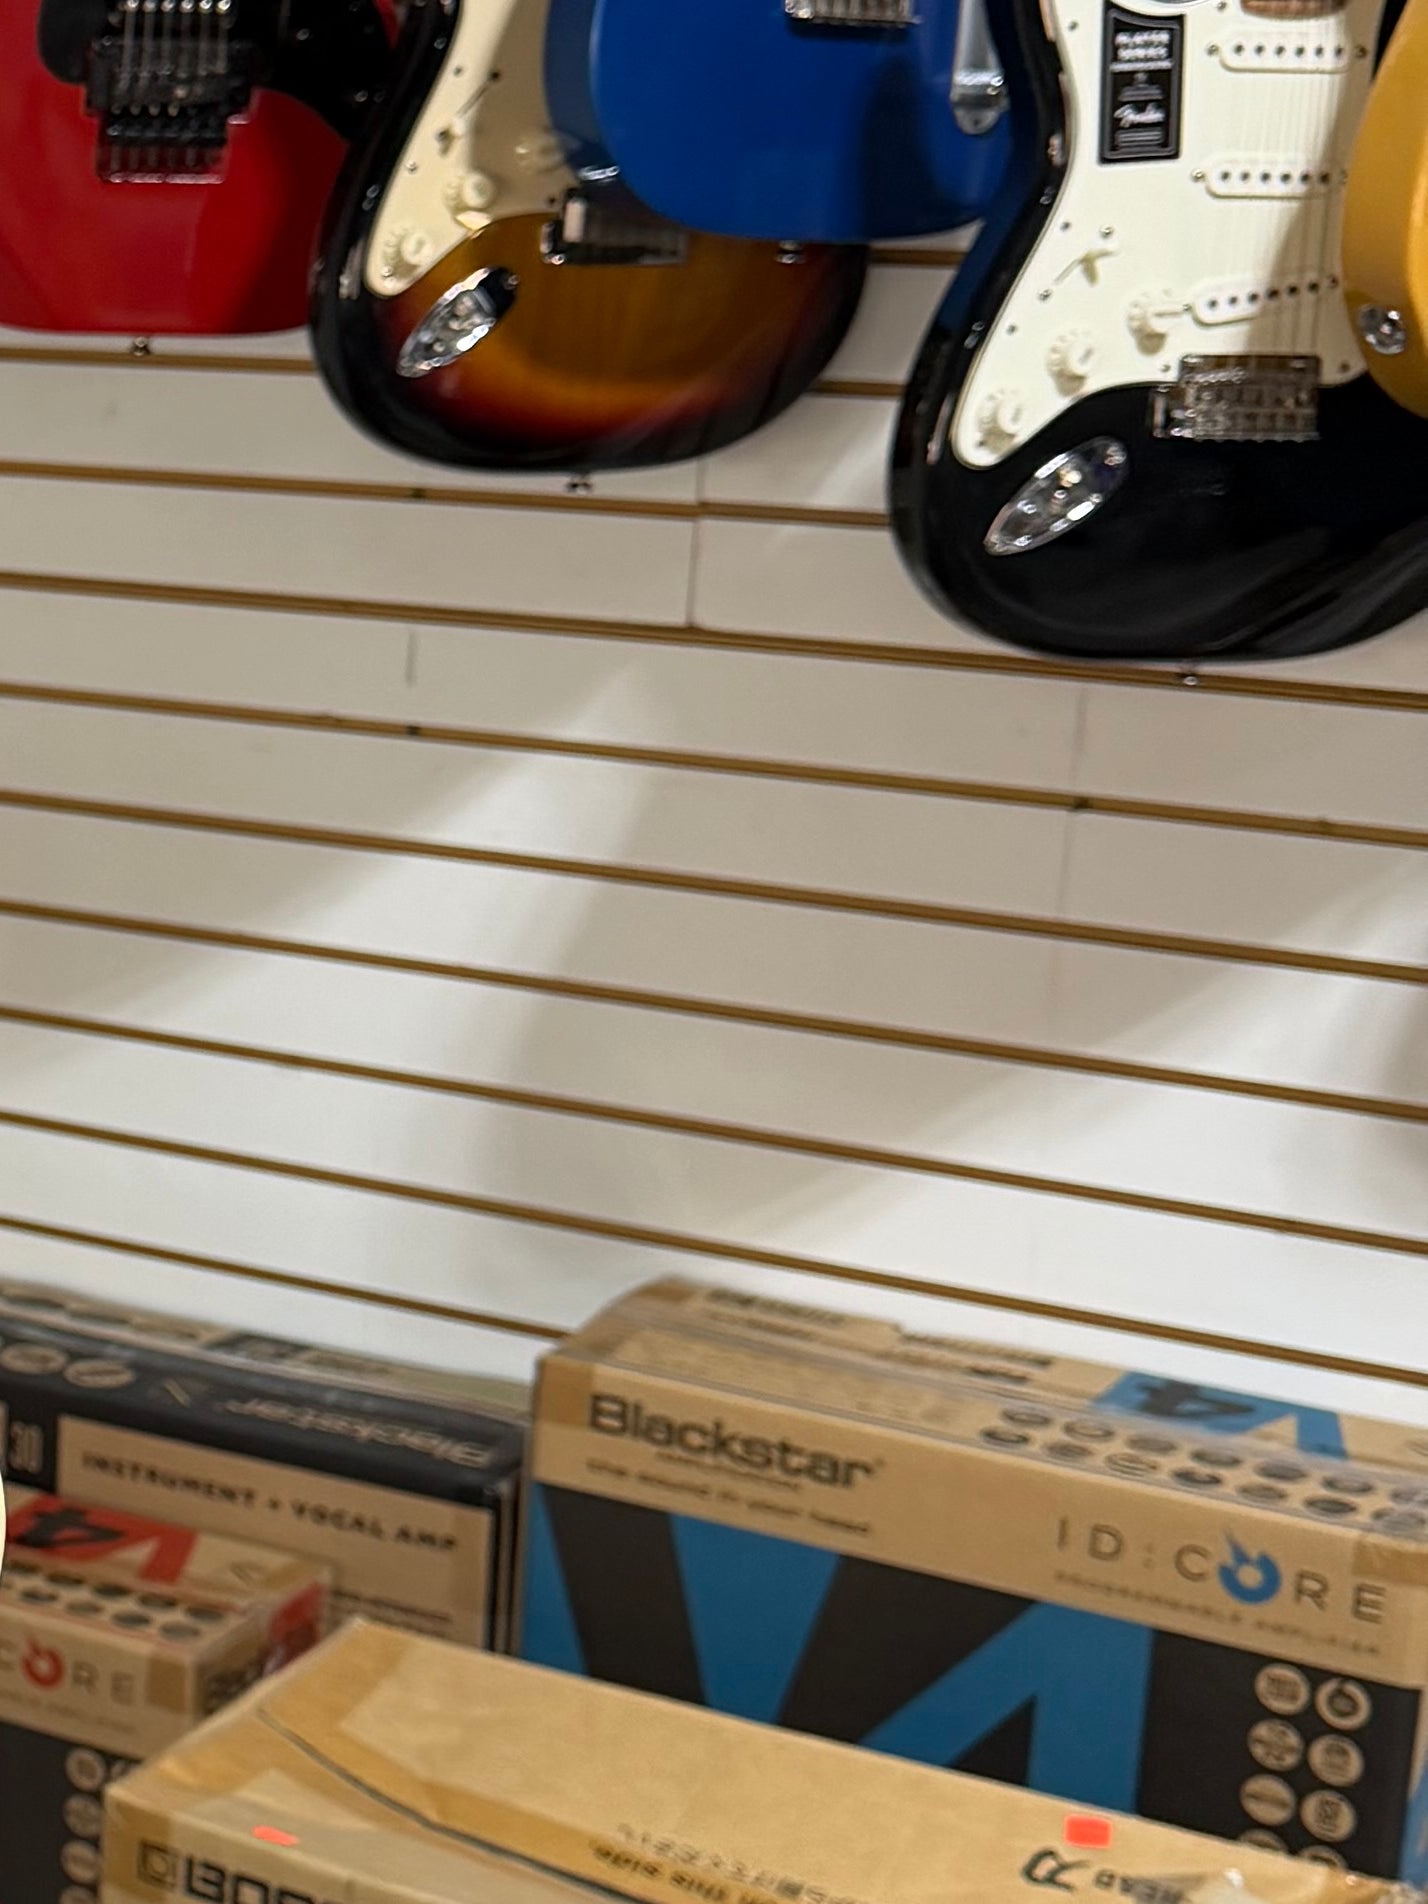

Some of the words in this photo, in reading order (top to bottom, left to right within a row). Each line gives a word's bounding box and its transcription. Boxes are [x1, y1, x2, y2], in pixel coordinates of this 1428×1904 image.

[588, 1392, 877, 1489] Blackstar
[81, 1451, 257, 1510] INSTRUMENT
[292, 1502, 385, 1540] VOCAL
[397, 1526, 459, 1552] AMP
